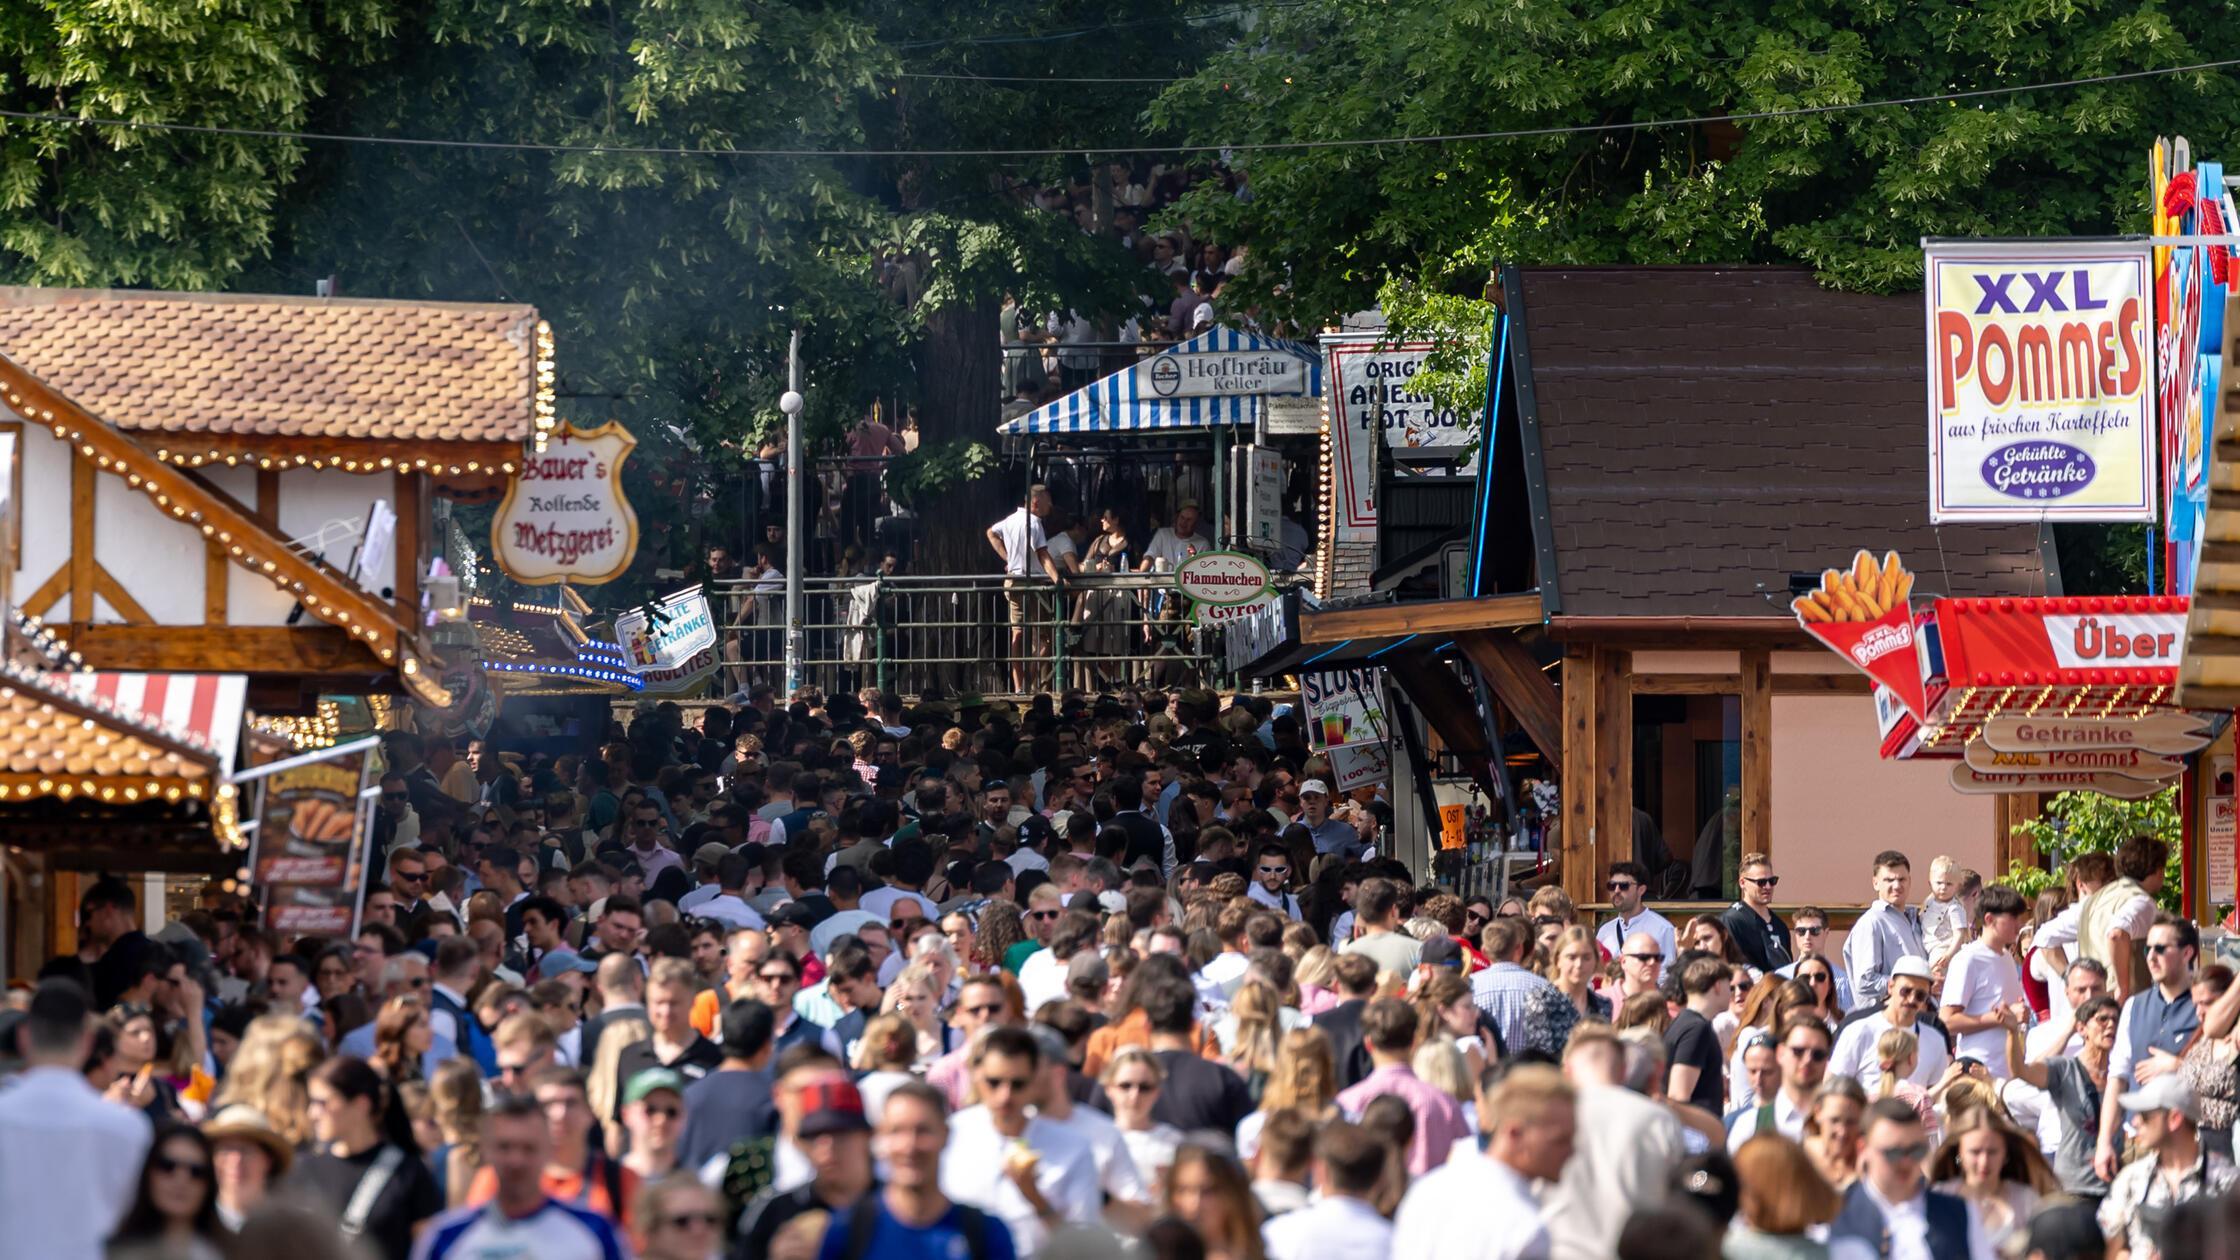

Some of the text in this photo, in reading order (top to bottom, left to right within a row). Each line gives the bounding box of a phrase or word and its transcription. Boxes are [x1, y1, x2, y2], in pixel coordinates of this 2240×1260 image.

[1973, 270, 2108, 315] XXL
[1188, 356, 1288, 378] Hofbräu
[1214, 376, 1262, 391] Keller
[1949, 410, 2130, 441] aus frischen Kartoffeln
[2004, 445, 2067, 467] Gekühlte
[1994, 462, 2087, 492] Getränke
[529, 494, 601, 512] Rollende
[513, 517, 614, 566] Metzgerei
[1182, 571, 1263, 587] Flammkuchen
[2074, 618, 2175, 659] Über
[2016, 724, 2133, 743] Getränke
[1992, 751, 2041, 766] XXL
